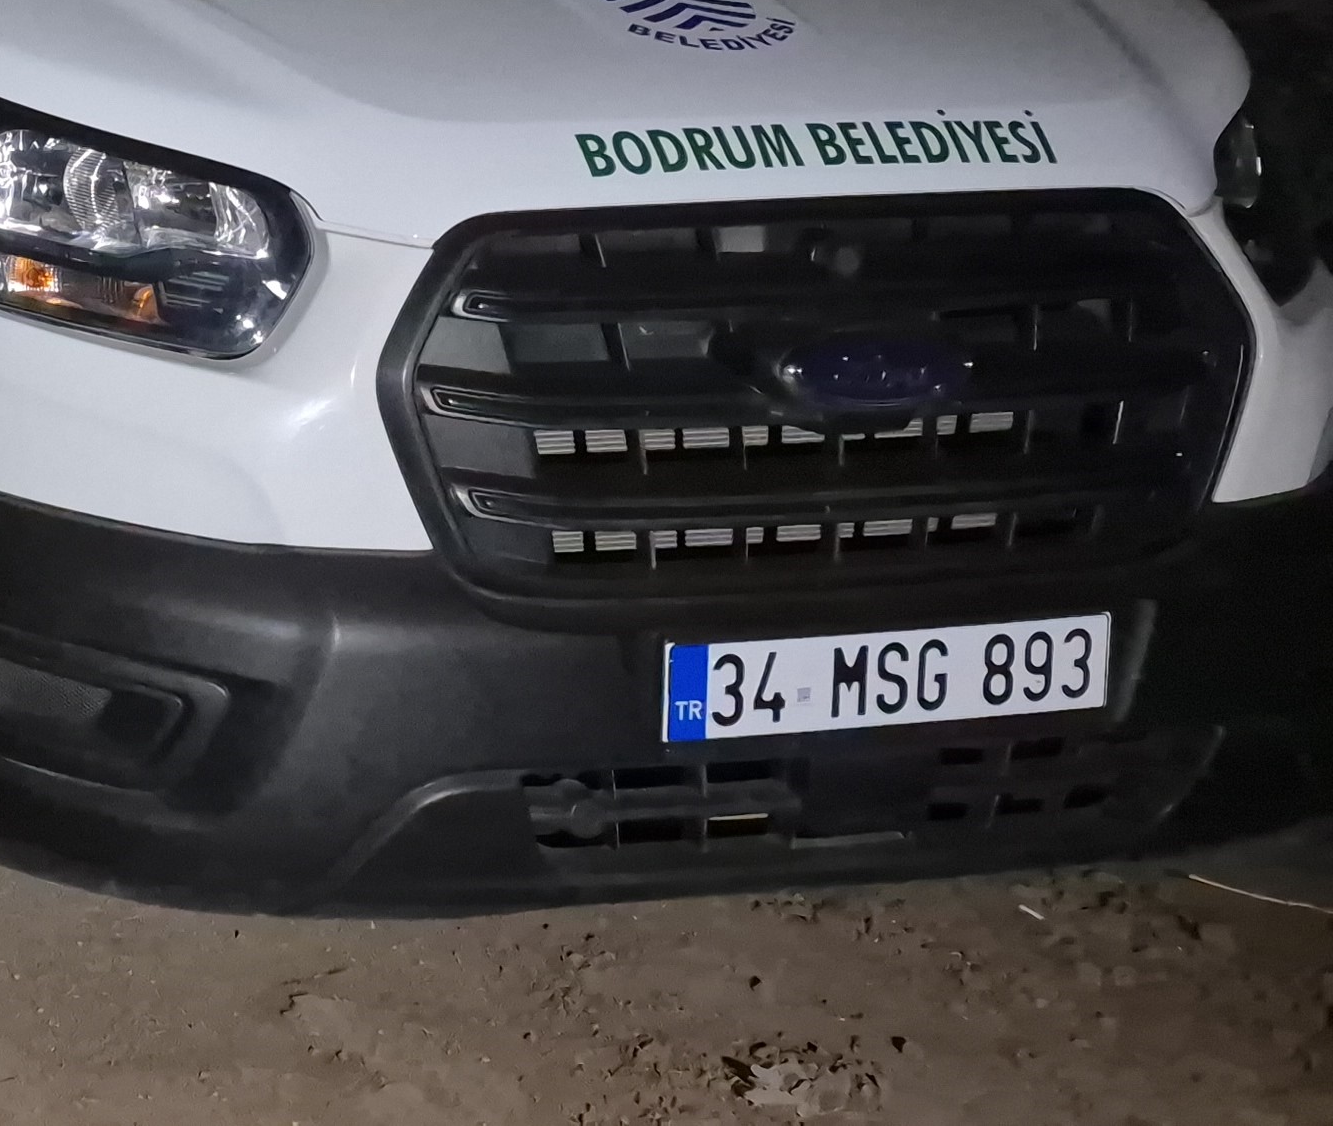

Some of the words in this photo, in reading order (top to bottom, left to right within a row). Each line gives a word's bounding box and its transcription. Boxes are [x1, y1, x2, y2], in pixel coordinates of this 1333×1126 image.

[627, 17, 796, 51] BELEDİYESİ
[575, 122, 805, 178] BODRUM
[806, 109, 1058, 165] BELEDİYESİ
[711, 651, 786, 727] 34
[831, 639, 949, 718] MSG
[983, 627, 1093, 706] 893
[674, 700, 703, 721] TR
